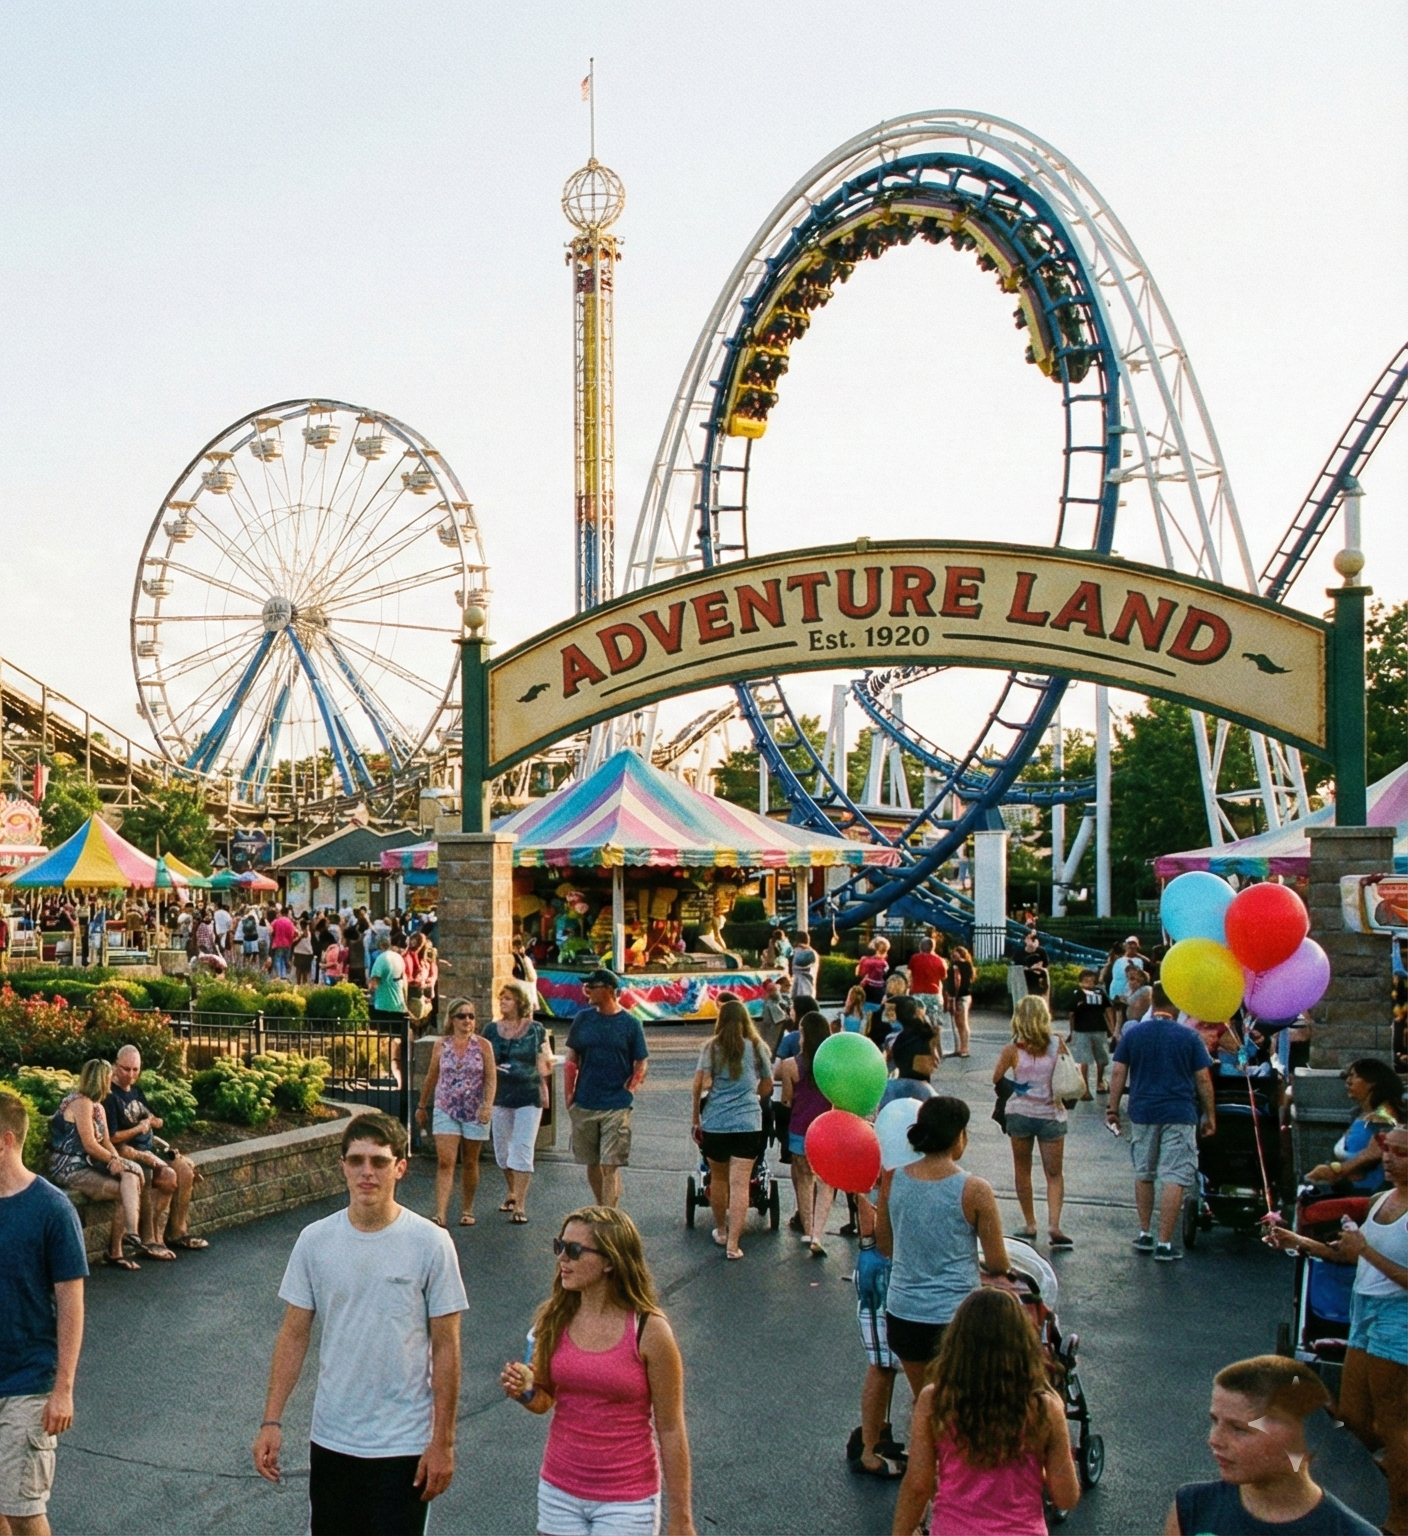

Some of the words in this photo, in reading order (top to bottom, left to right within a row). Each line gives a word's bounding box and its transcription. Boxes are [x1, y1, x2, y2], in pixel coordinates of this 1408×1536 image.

[560, 565, 985, 699] ADVENTURE
[1006, 571, 1232, 666] LAND
[808, 629, 856, 651] Est.
[864, 625, 930, 647] 1920
